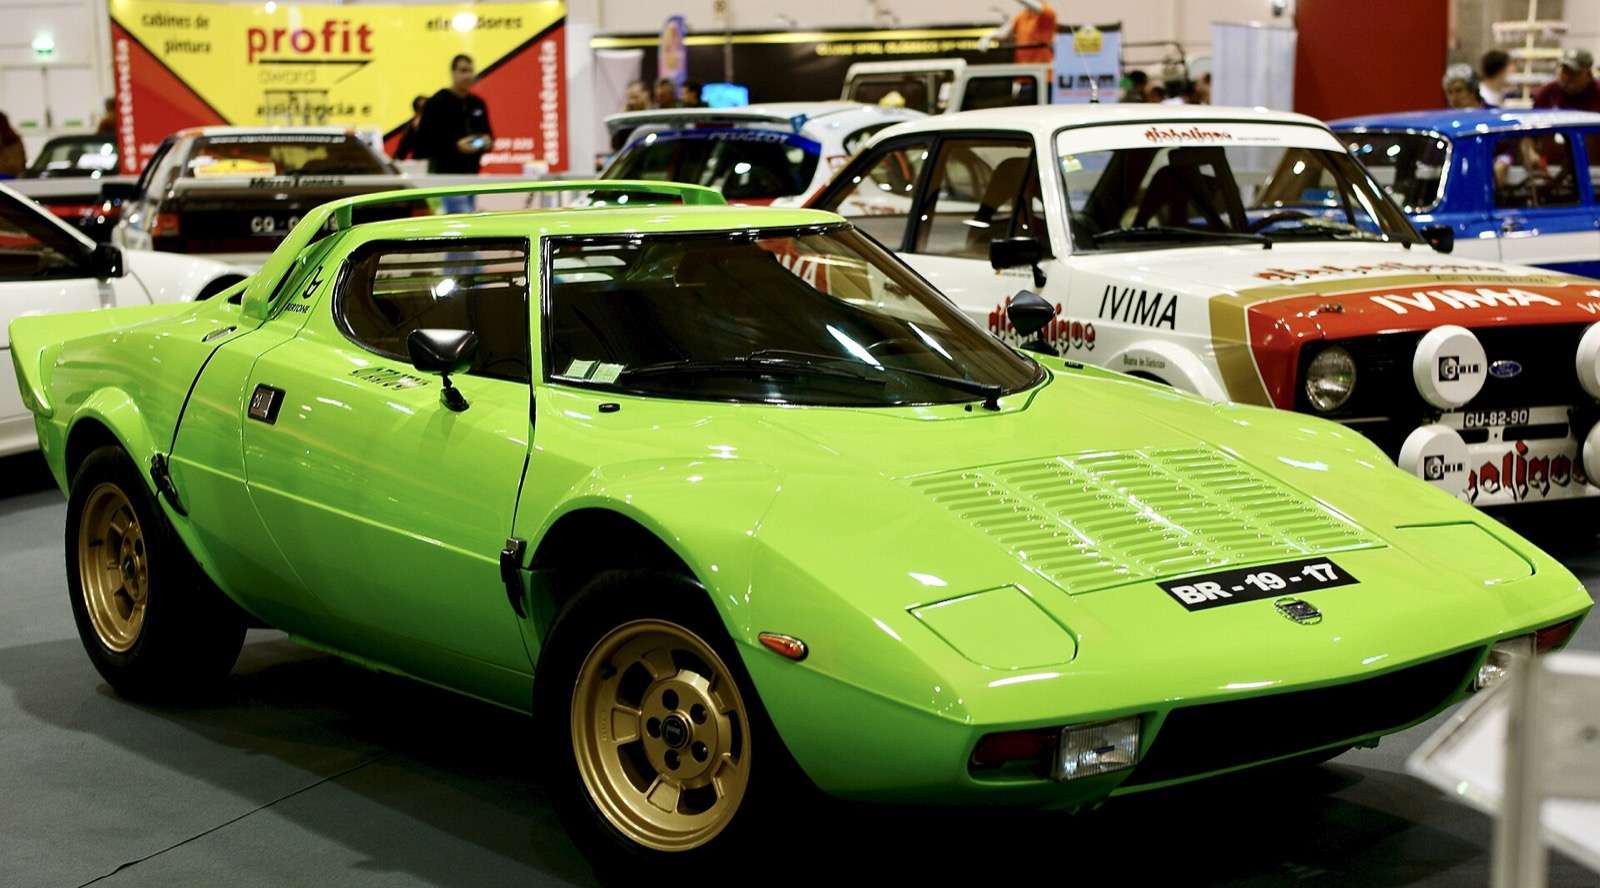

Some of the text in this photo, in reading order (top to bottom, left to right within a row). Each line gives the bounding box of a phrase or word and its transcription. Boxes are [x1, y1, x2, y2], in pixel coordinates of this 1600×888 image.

[142, 13, 209, 28] cabines de
[426, 15, 521, 31] eledores
[164, 37, 212, 55] pintura
[246, 20, 373, 64] profit
[709, 131, 789, 144] PEUGEOT
[1099, 284, 1178, 331] IVIMA
[1370, 288, 1561, 315] IVIMA
[1465, 409, 1529, 427] GU-82-90
